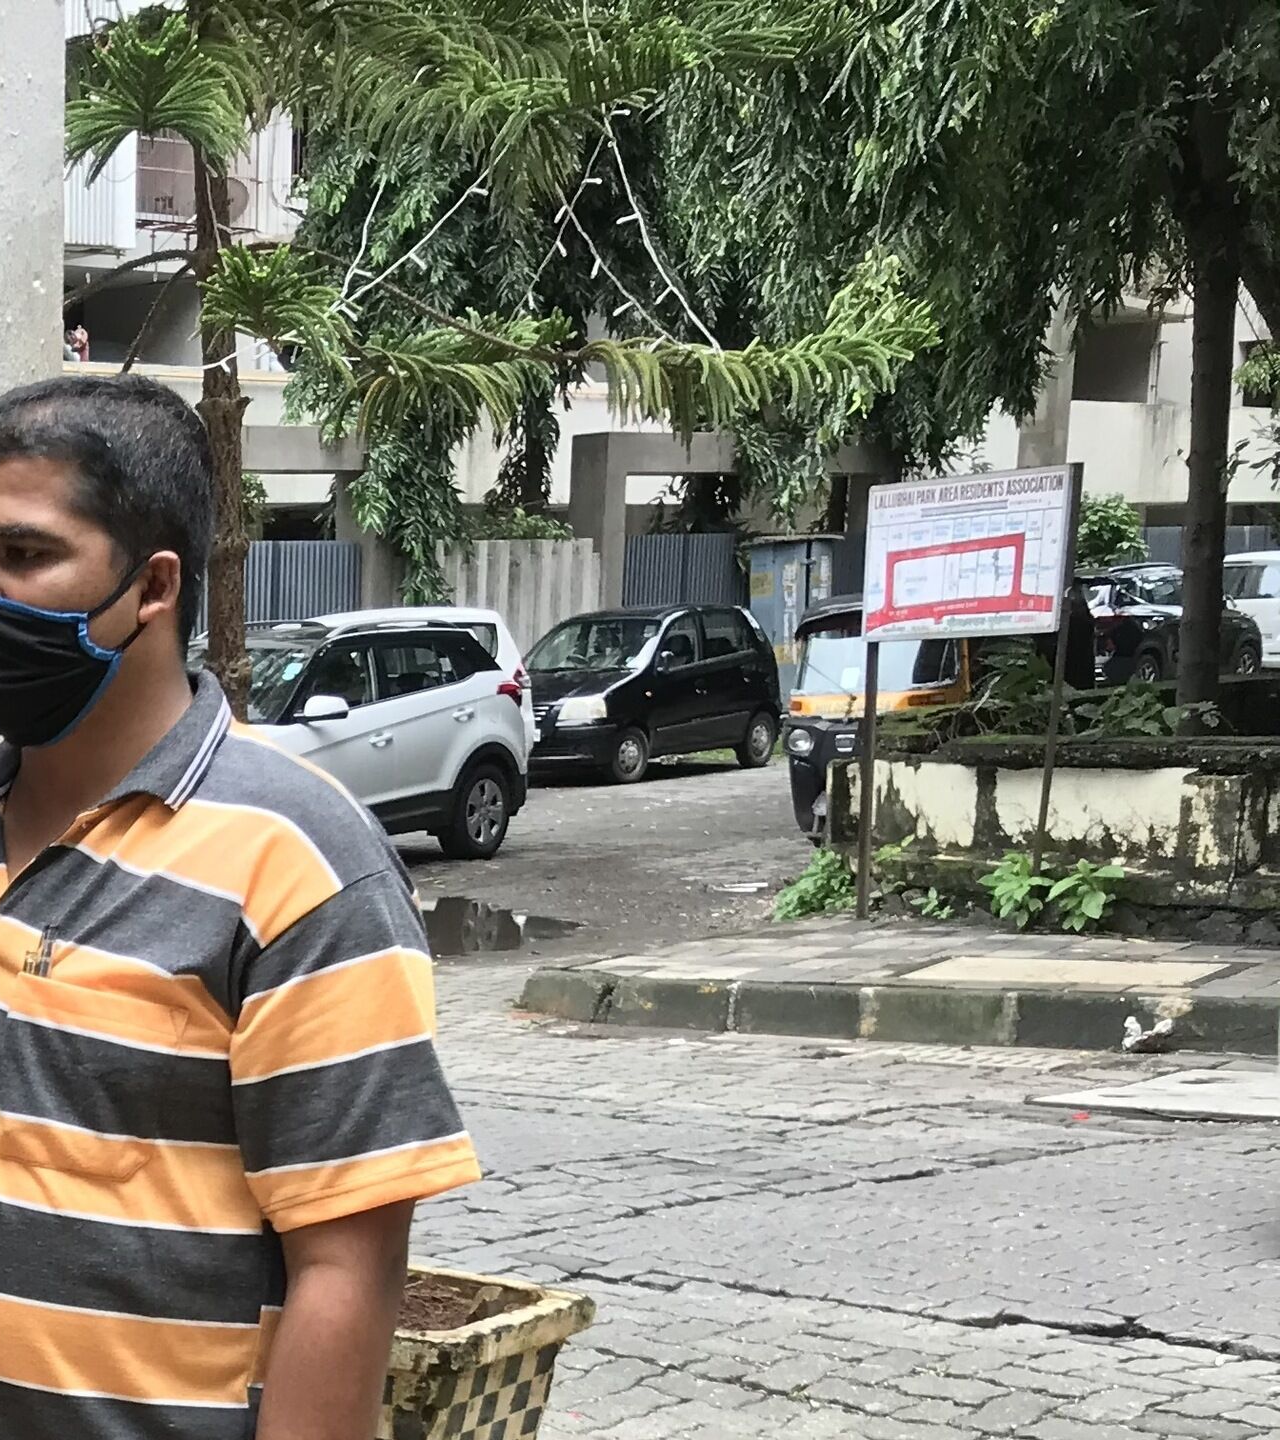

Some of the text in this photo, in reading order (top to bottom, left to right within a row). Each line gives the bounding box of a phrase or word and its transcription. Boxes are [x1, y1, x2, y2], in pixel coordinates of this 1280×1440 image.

[874, 475, 1064, 509] LALLUBHAI PARK AREA RESIDENTS ASSOCIATION
